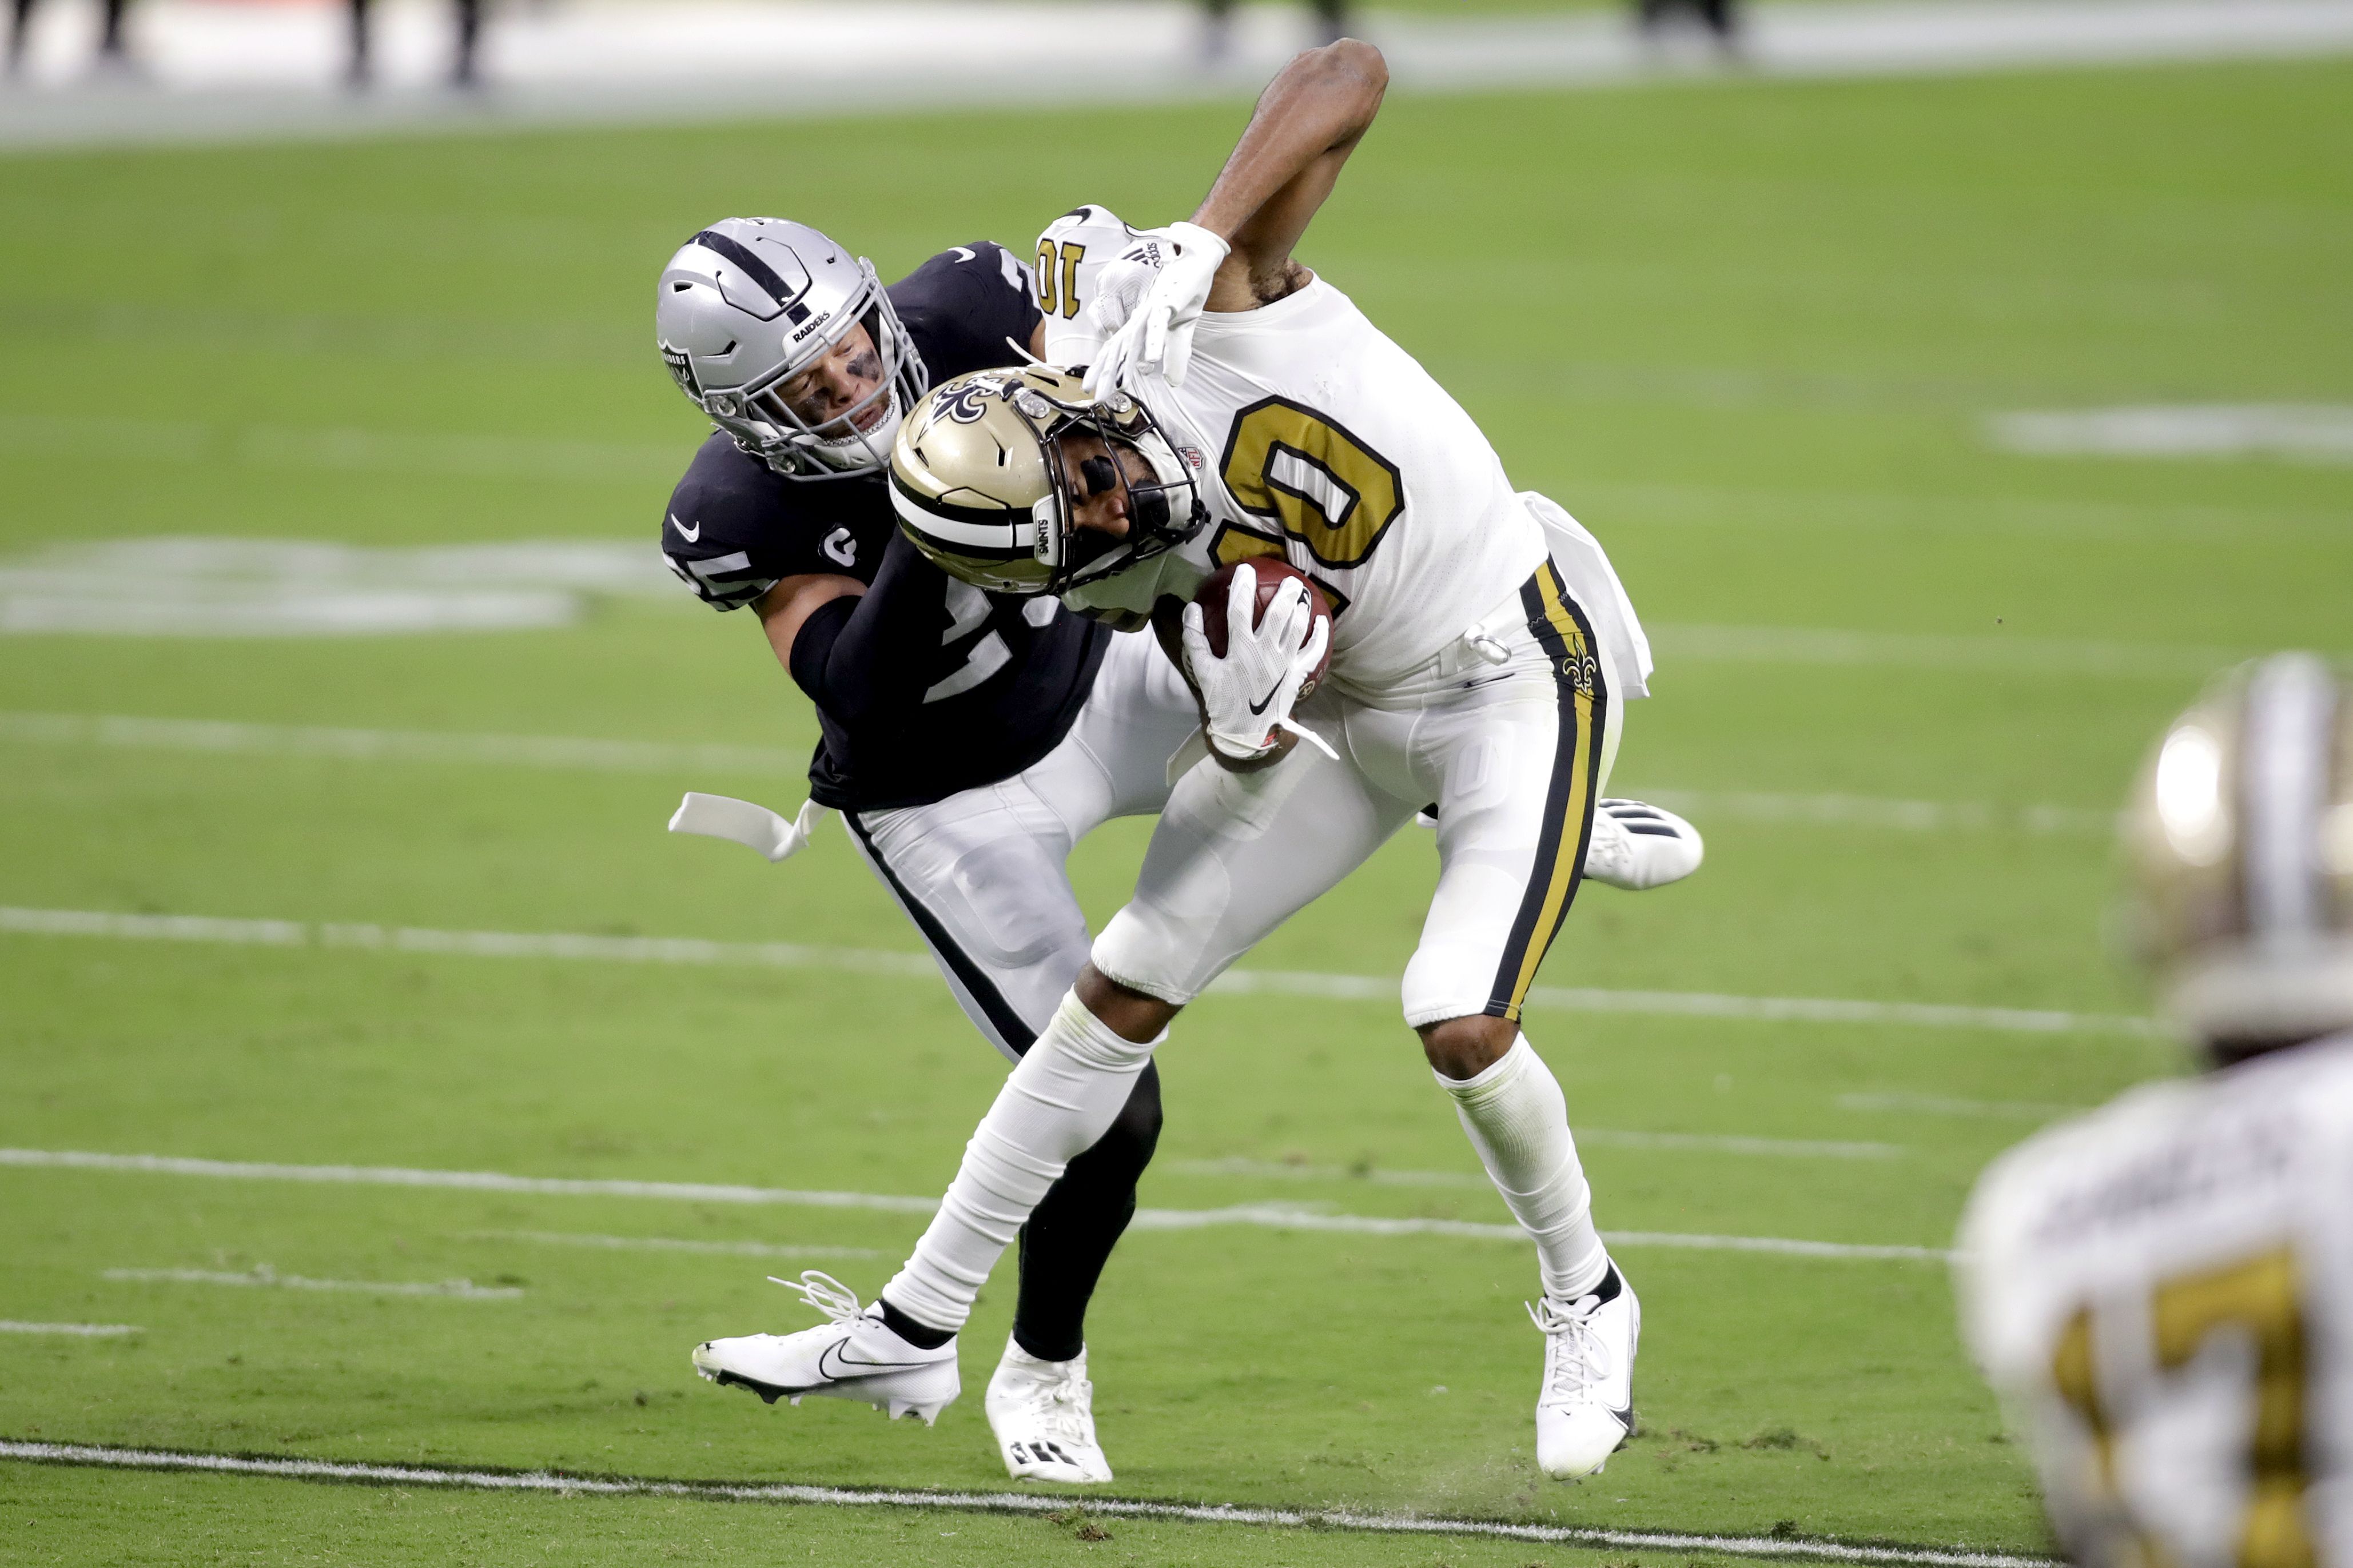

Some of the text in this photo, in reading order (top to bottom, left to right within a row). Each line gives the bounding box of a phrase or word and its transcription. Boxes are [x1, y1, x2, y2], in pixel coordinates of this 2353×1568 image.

[1035, 238, 1086, 320] 10
[793, 310, 830, 343] RAIDERS
[1038, 518, 1049, 554] SAINTS
